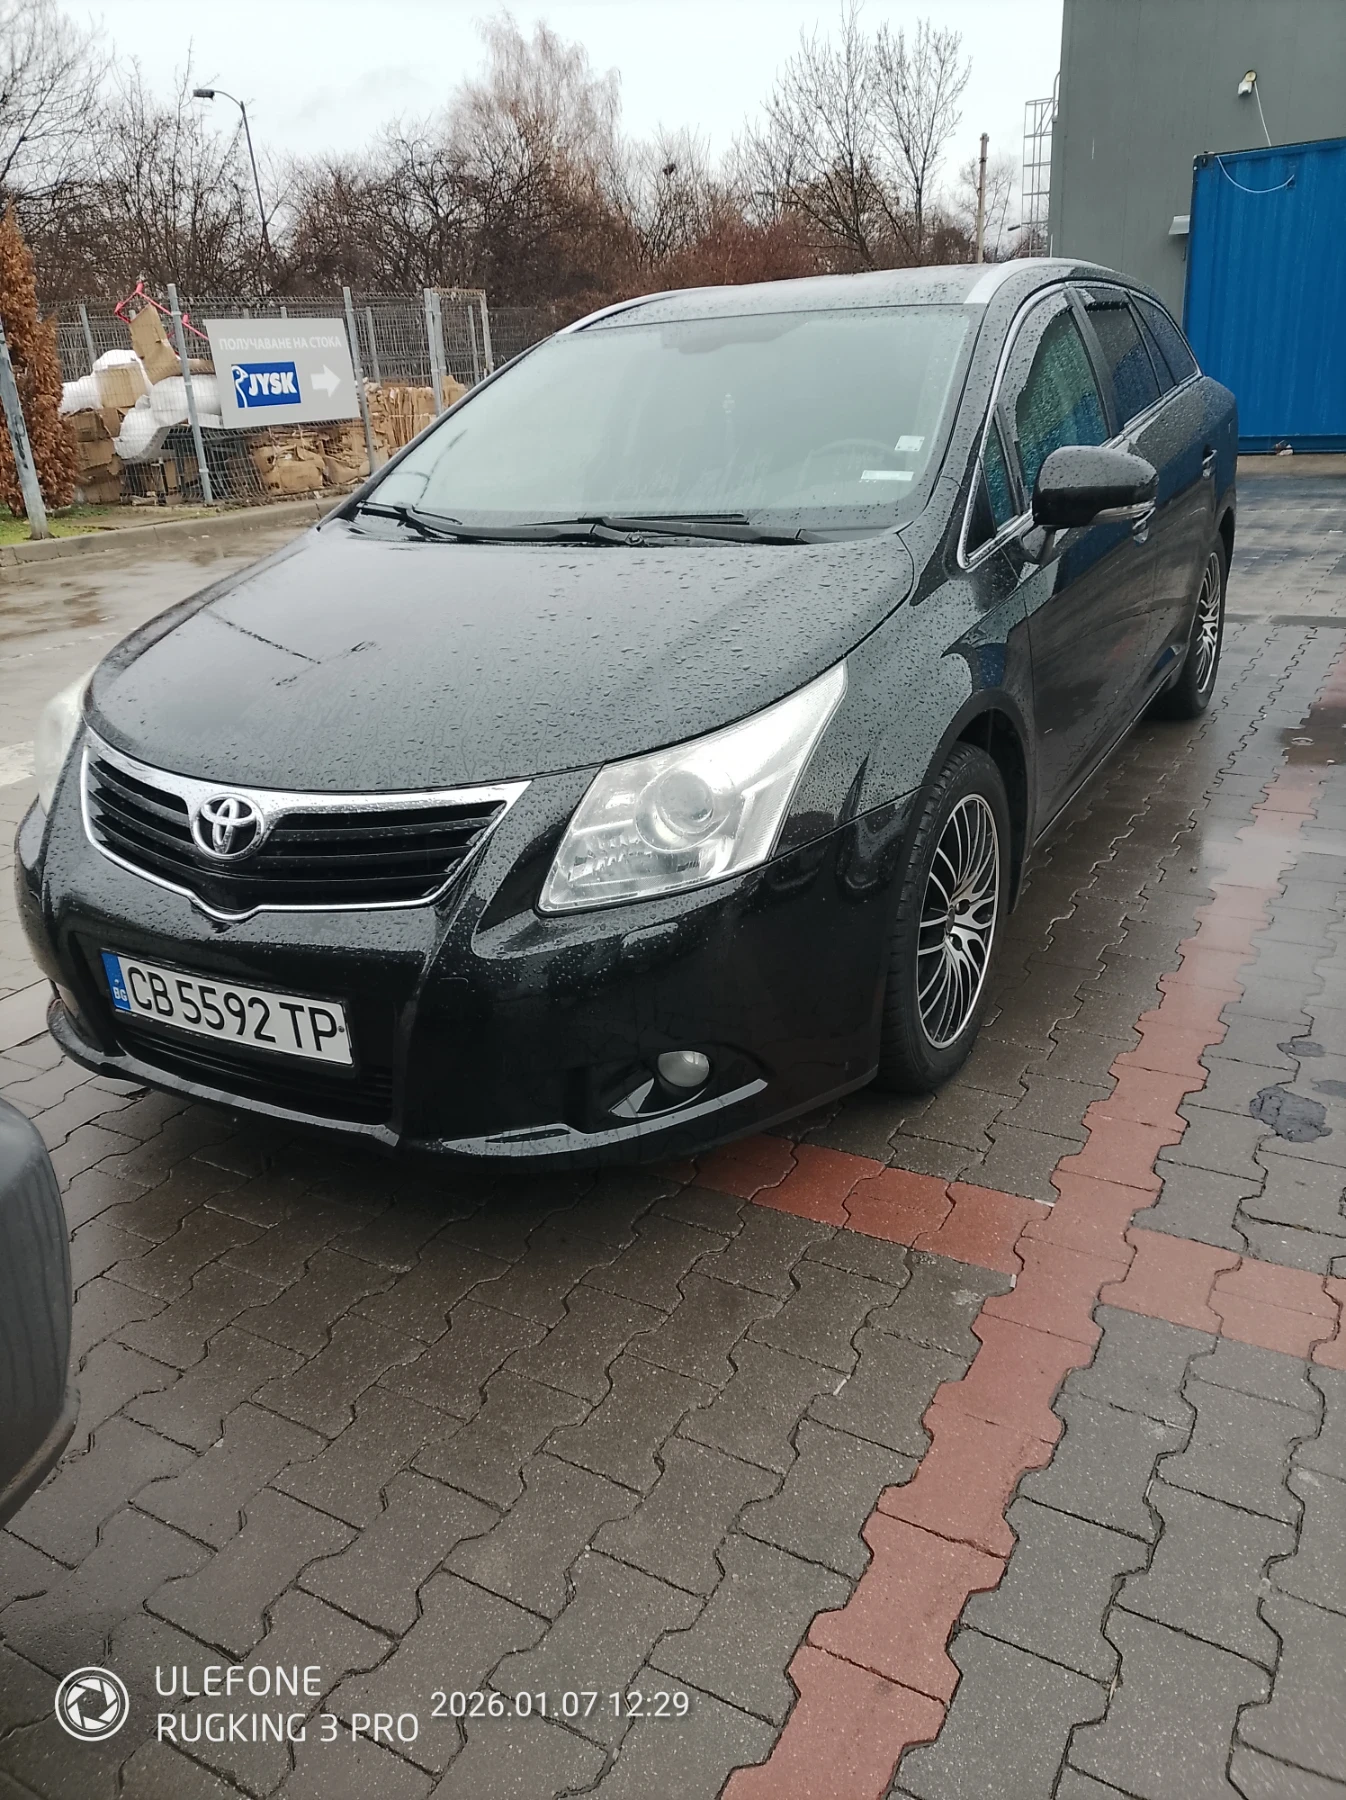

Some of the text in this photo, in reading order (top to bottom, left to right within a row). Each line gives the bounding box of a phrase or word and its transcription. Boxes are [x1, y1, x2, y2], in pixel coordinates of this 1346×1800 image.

[219, 336, 342, 350] ПОЛУЧАВАНЕ НА СТОКА
[248, 371, 298, 396] JYSK
[112, 987, 128, 1002] BG
[175, 980, 277, 1043] 5592
